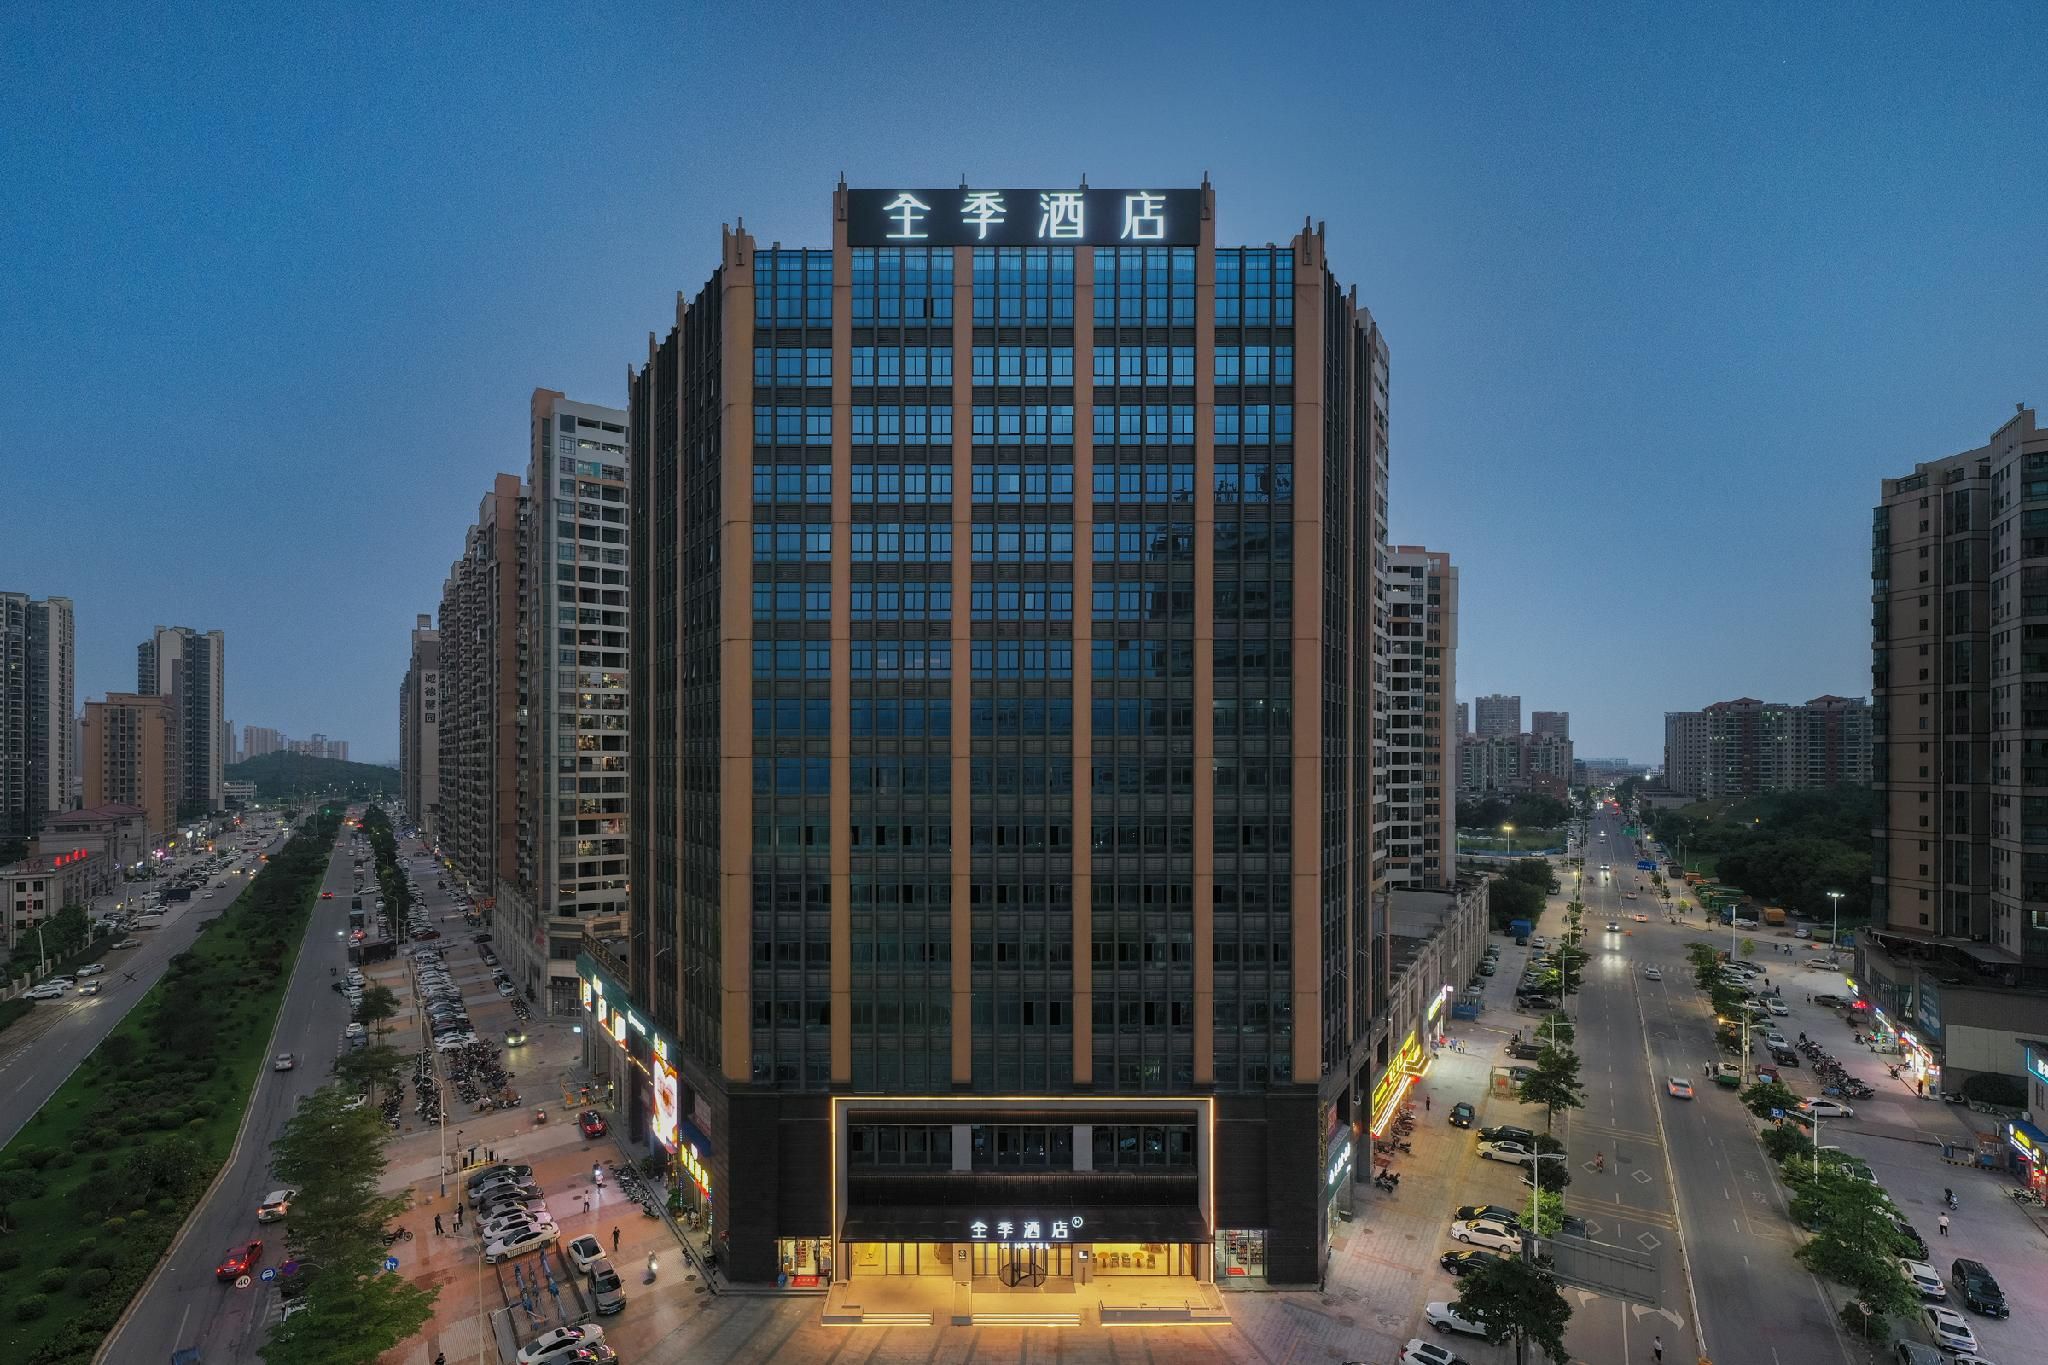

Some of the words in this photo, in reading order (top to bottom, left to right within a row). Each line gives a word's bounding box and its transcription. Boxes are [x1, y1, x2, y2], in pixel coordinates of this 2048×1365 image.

[882, 192, 1166, 240] 全季酒店
[970, 1220, 1069, 1239] 全季酒店
